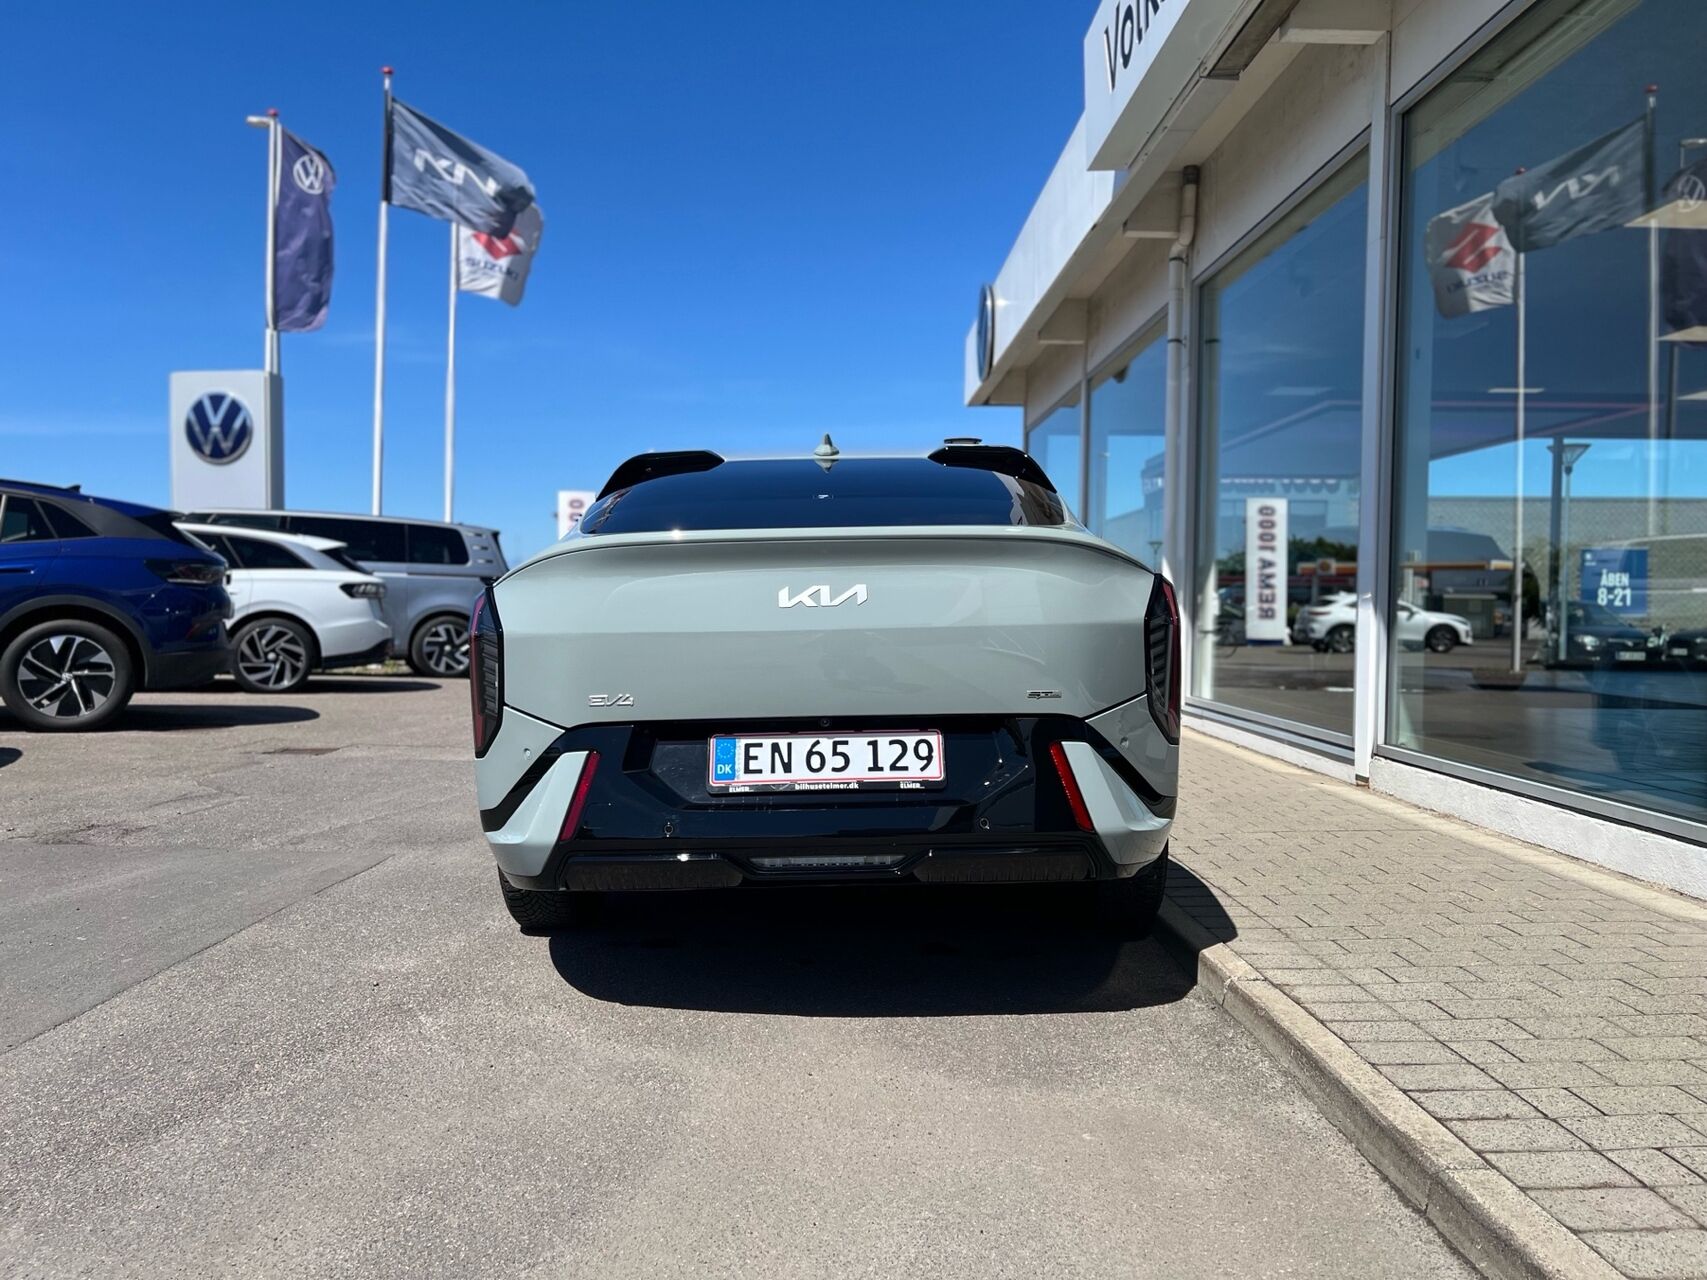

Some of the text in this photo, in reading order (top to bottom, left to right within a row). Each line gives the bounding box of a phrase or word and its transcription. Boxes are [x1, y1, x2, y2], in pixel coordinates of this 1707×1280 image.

[1104, 0, 1166, 91] Volk
[1600, 568, 1629, 587] ÅBEN
[778, 583, 868, 608] KIA
[1597, 587, 1631, 607] 8-21
[589, 694, 634, 707] EV4
[743, 738, 934, 775] EN 65 129
[717, 764, 732, 774] DK
[795, 782, 859, 791] bilhusetelmer.dk
